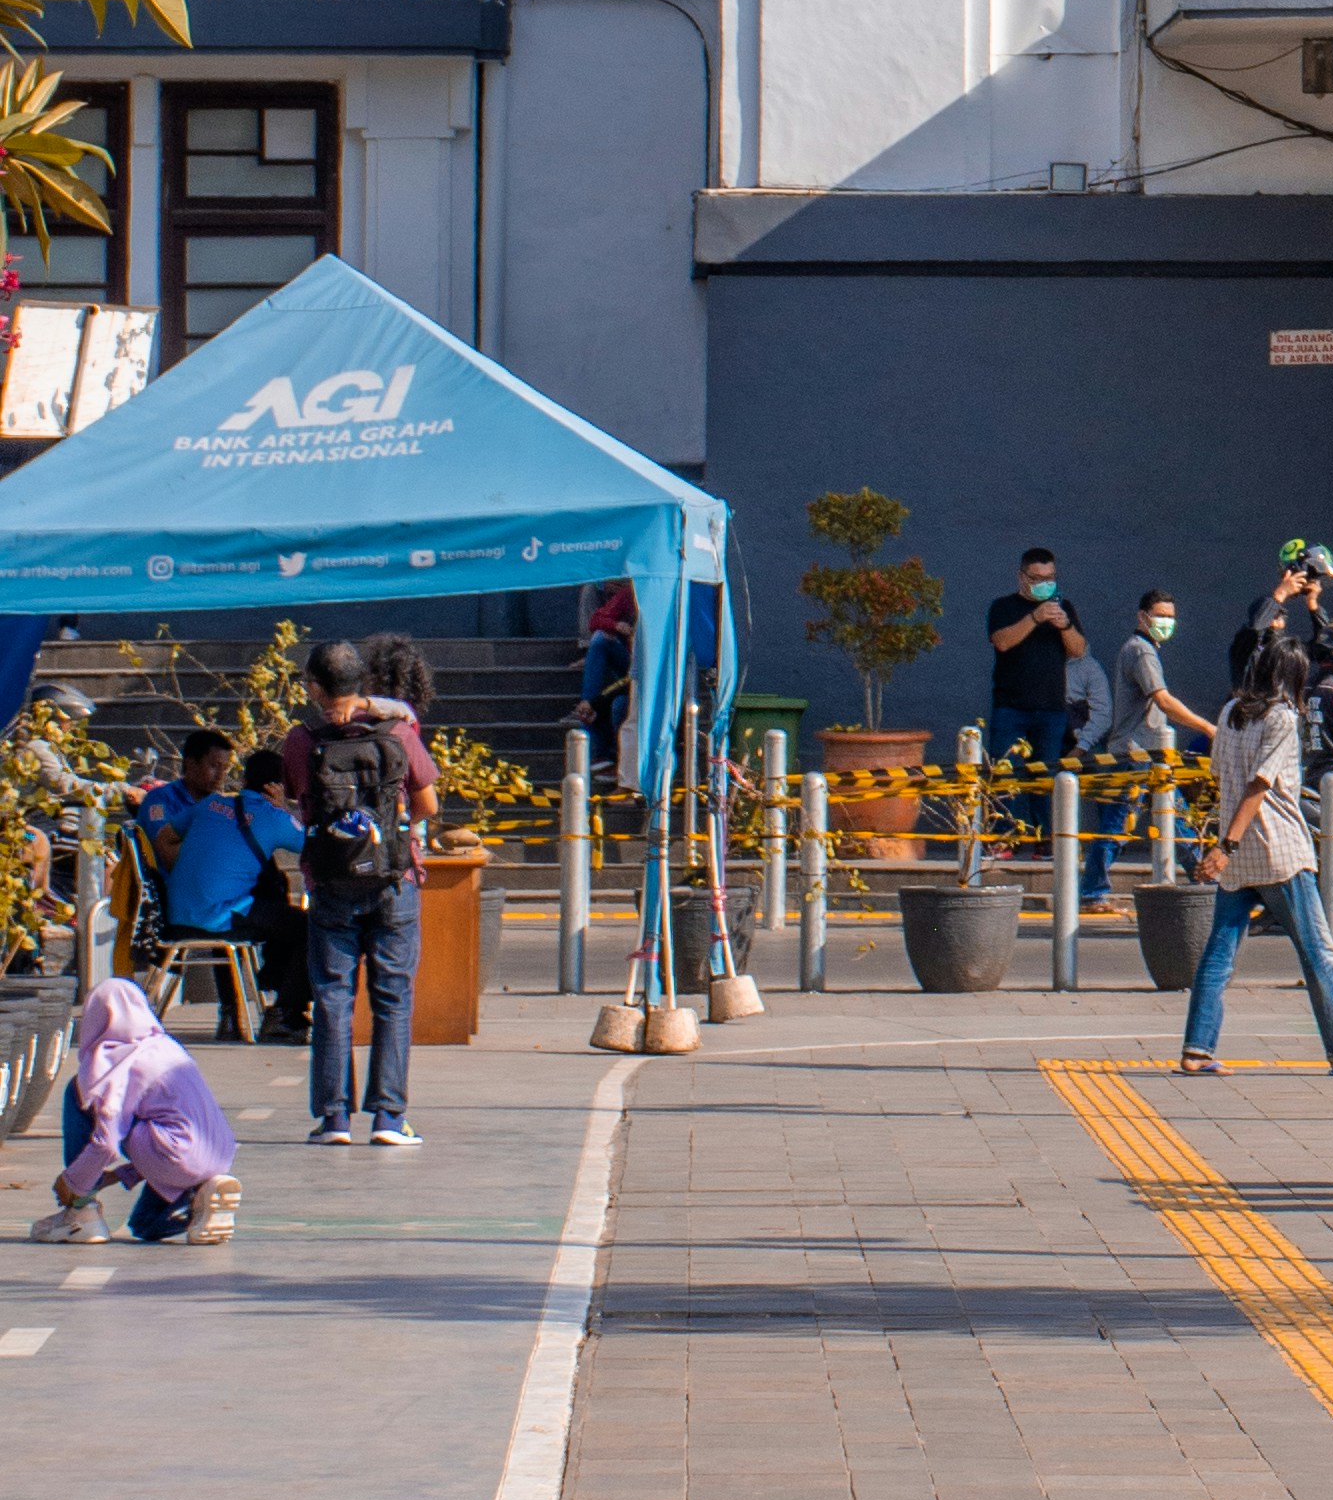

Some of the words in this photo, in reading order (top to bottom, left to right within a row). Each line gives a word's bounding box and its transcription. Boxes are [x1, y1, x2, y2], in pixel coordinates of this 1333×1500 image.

[1276, 333, 1333, 343] DILARANG
[1290, 355, 1319, 363] AREA
[216, 363, 417, 431] AGI
[172, 434, 251, 451] BANK
[257, 429, 352, 449] ARTHA
[359, 418, 454, 442] GRAHA
[201, 440, 423, 468] INTERNASIONAL
[547, 536, 624, 556] @temanagi
